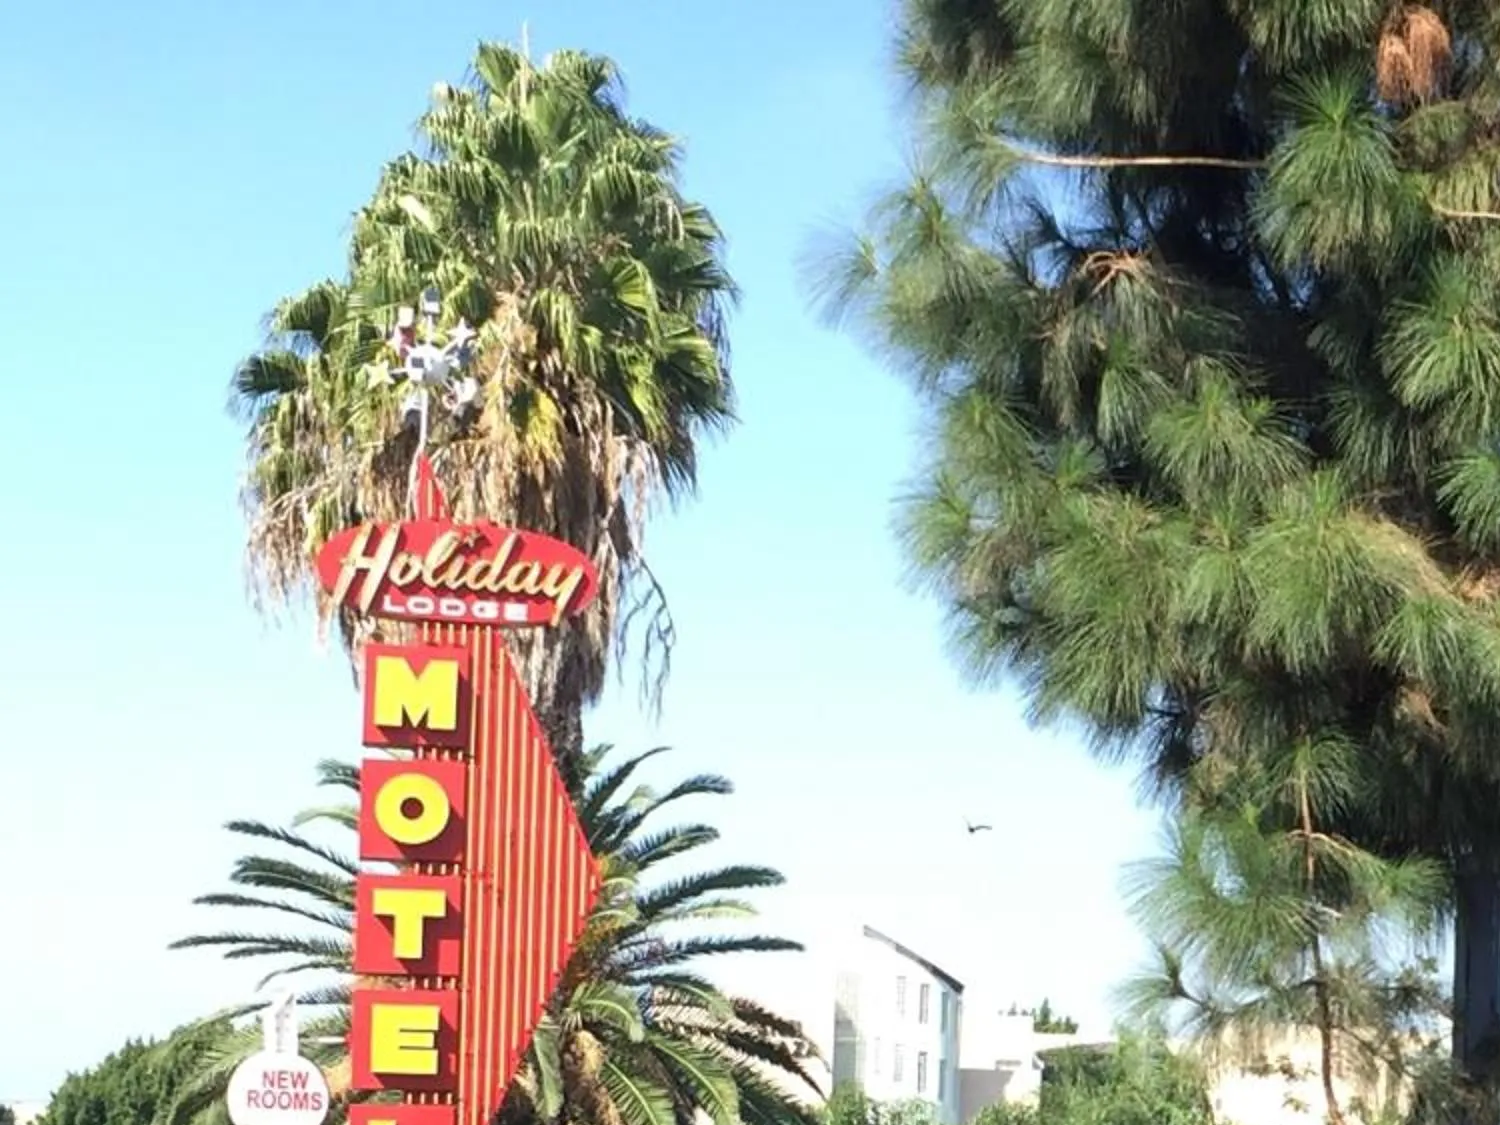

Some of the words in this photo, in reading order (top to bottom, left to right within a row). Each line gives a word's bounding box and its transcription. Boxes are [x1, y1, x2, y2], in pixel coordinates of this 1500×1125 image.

[330, 521, 585, 627] Holiday
[381, 595, 529, 622] LODGE
[262, 1070, 310, 1090] NEW
[247, 1090, 323, 1111] ROOMS
